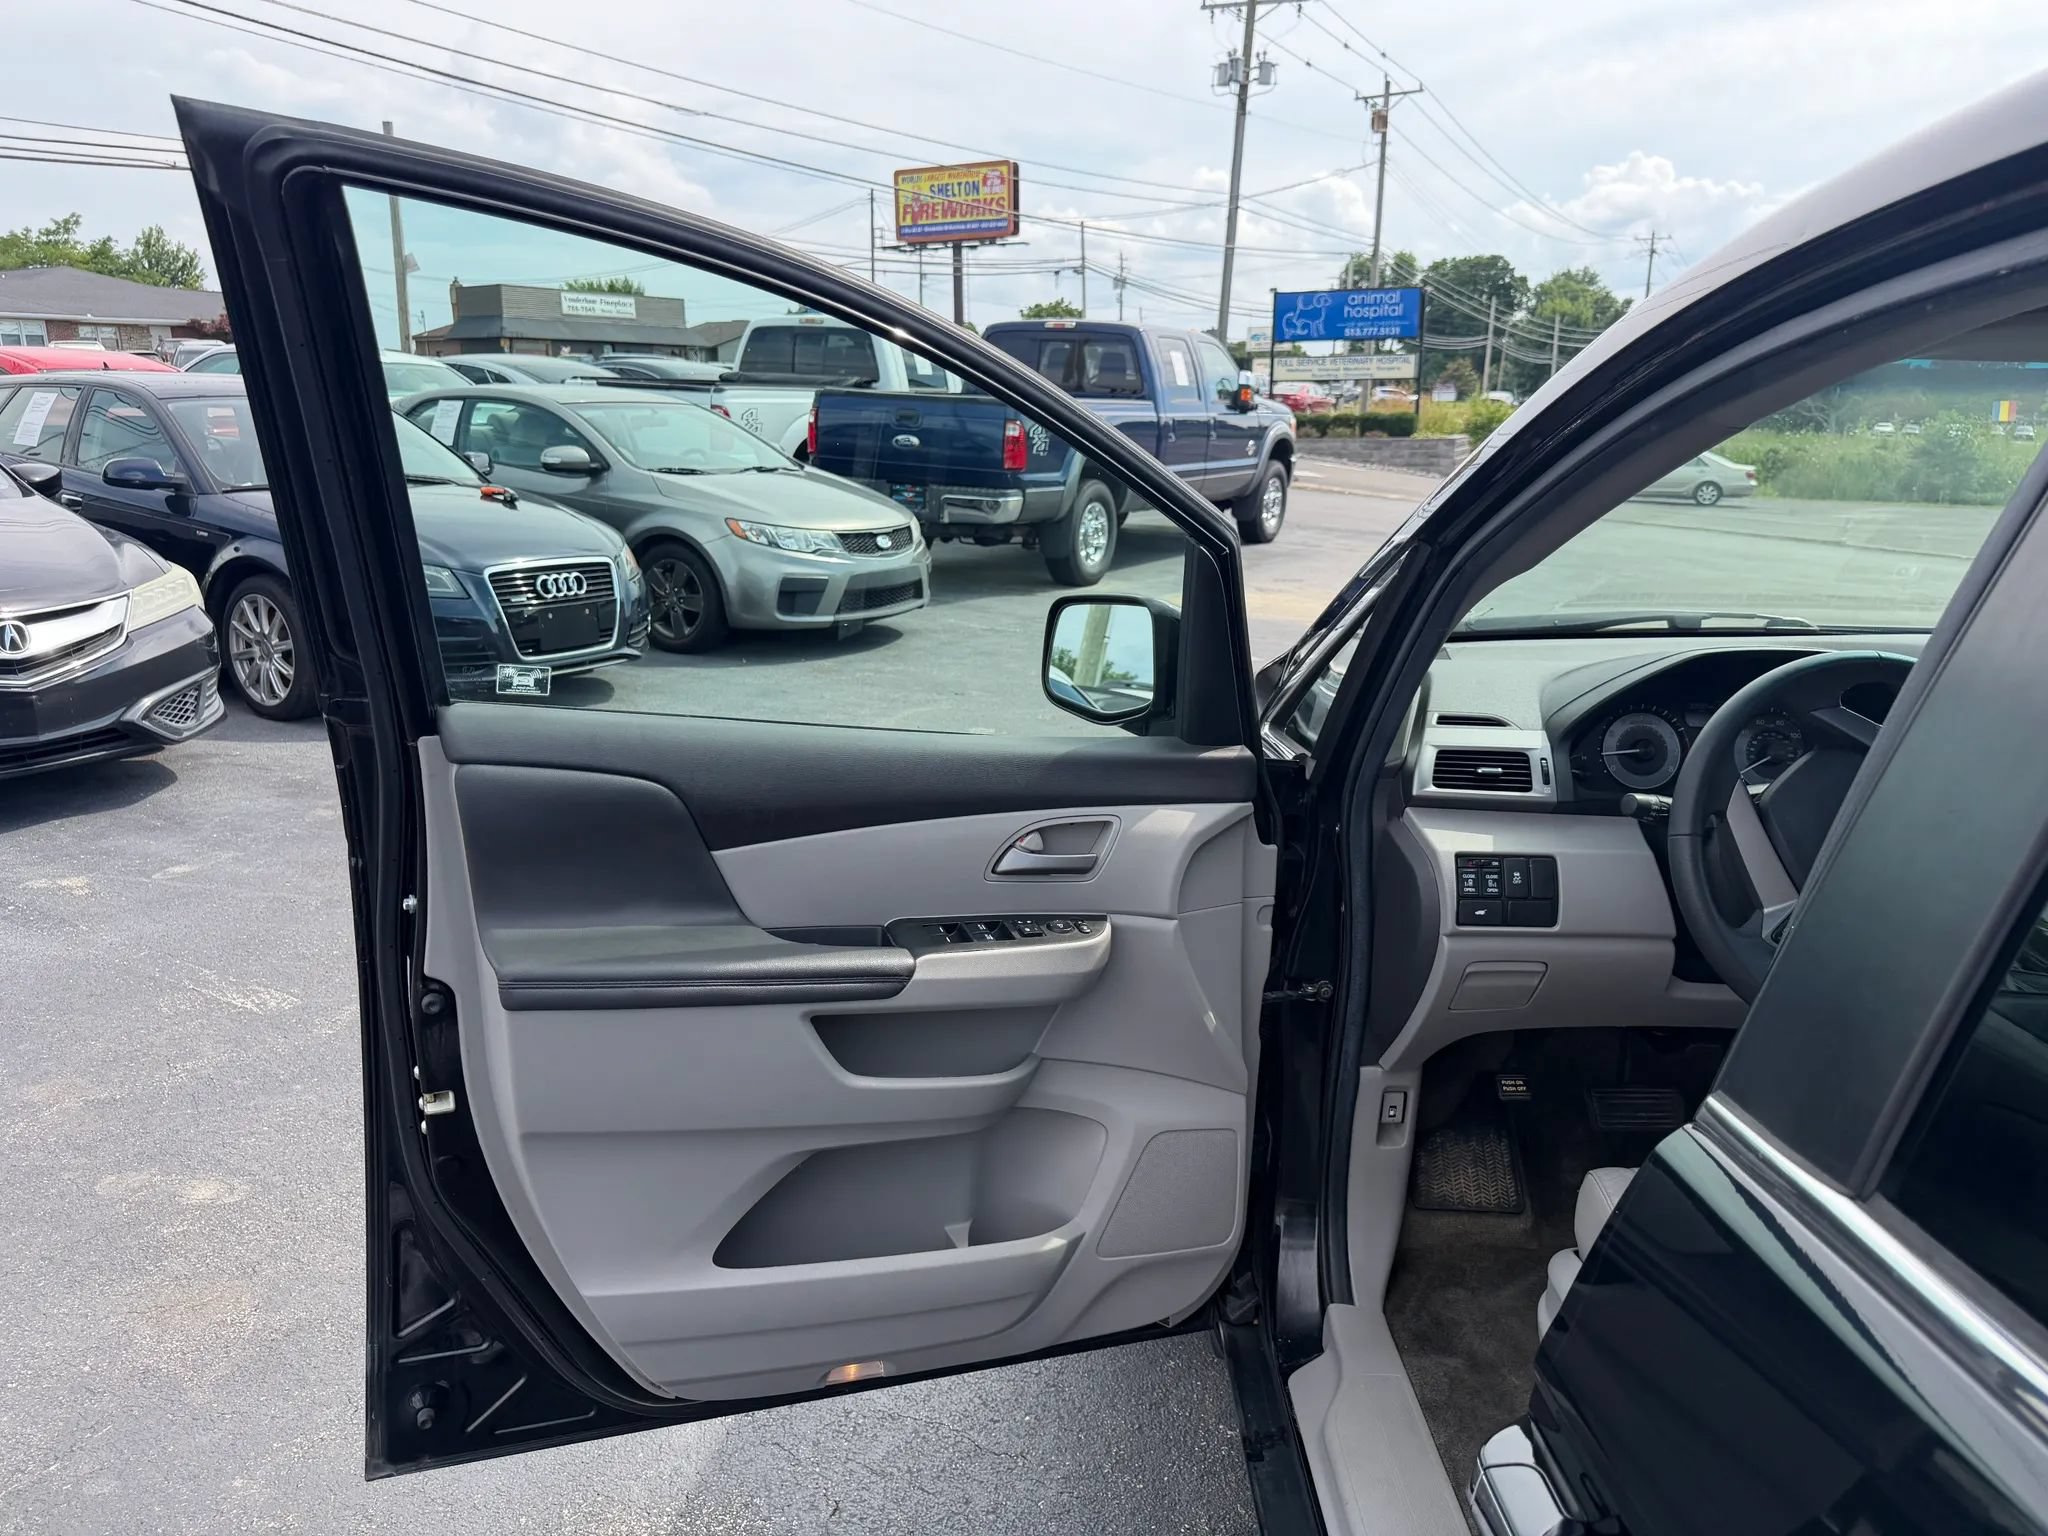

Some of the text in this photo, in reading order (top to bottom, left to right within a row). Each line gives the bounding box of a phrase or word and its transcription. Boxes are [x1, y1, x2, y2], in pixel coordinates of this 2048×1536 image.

[929, 180, 980, 198] SHELTON
[1347, 291, 1401, 305] animal
[1343, 303, 1404, 319] hospital
[1277, 359, 1294, 367] FULL
[1296, 358, 1328, 367] SERVICE
[1329, 357, 1373, 366] VETERINARY
[1376, 356, 1411, 366] HOSPITAL
